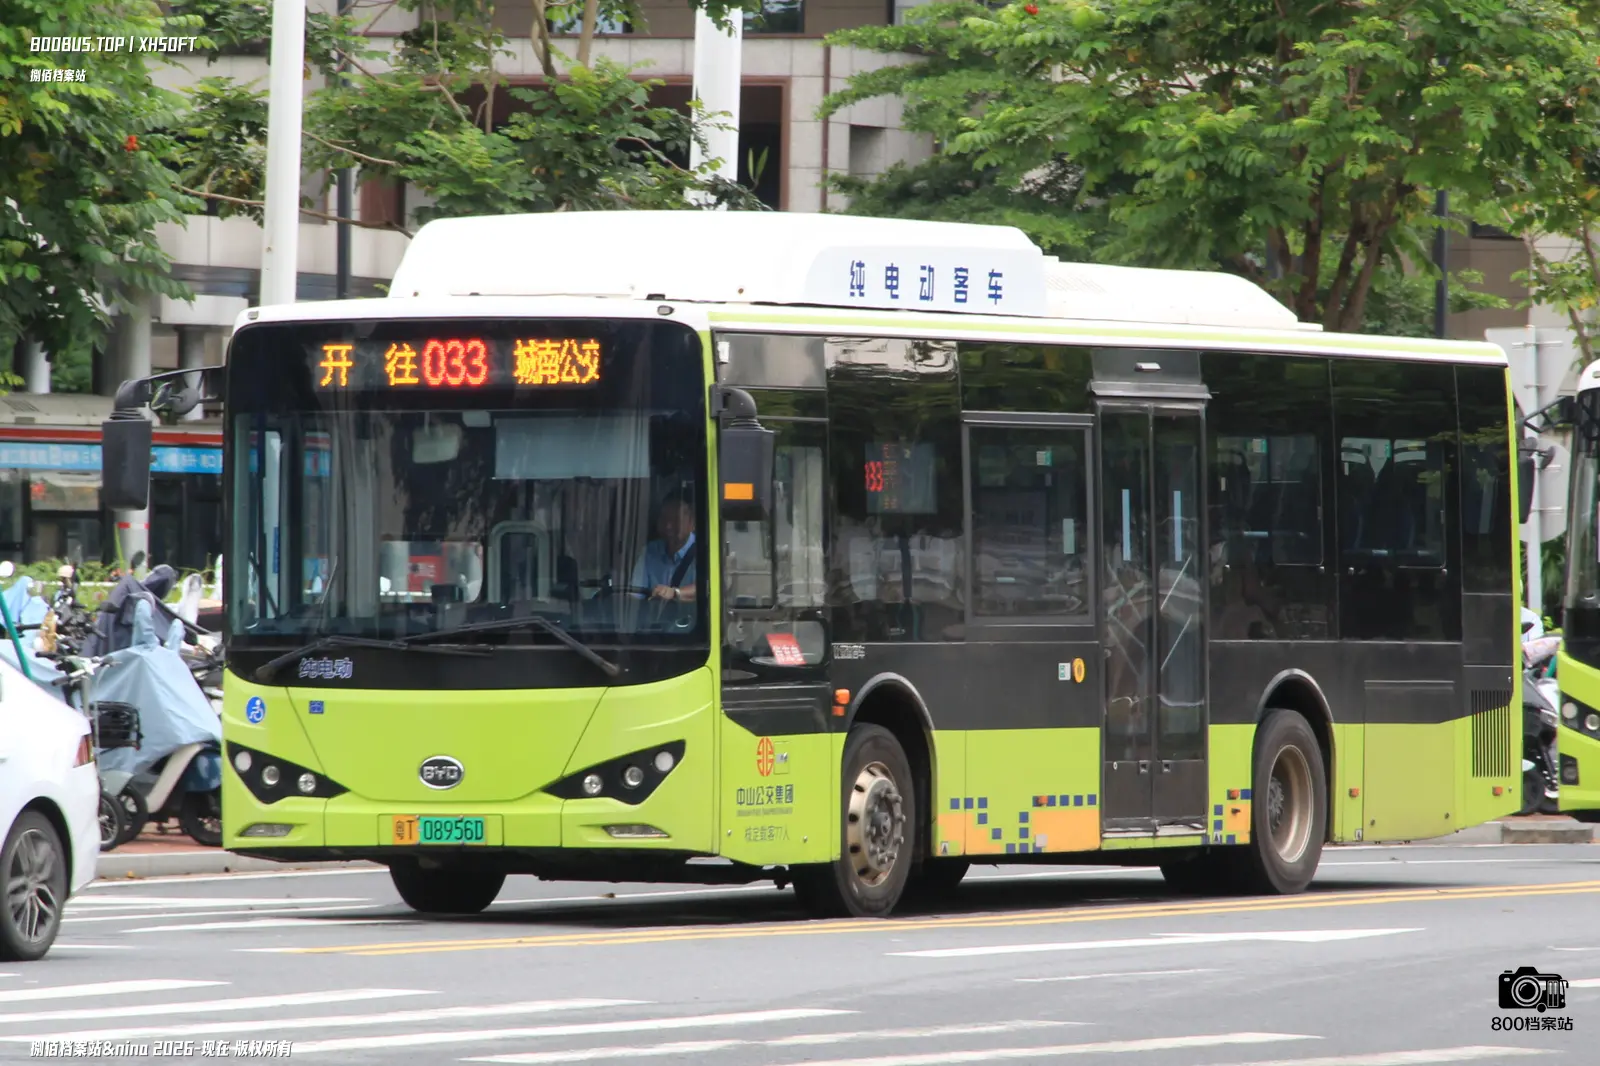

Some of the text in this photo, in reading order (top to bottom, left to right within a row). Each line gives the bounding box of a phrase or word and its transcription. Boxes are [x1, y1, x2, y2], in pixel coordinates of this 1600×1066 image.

[850, 260, 1003, 305] 纯电动客车
[422, 338, 488, 386] 033
[298, 657, 353, 679] 纯电动
[423, 766, 459, 780] BYD
[736, 783, 794, 806] 中山公交集团
